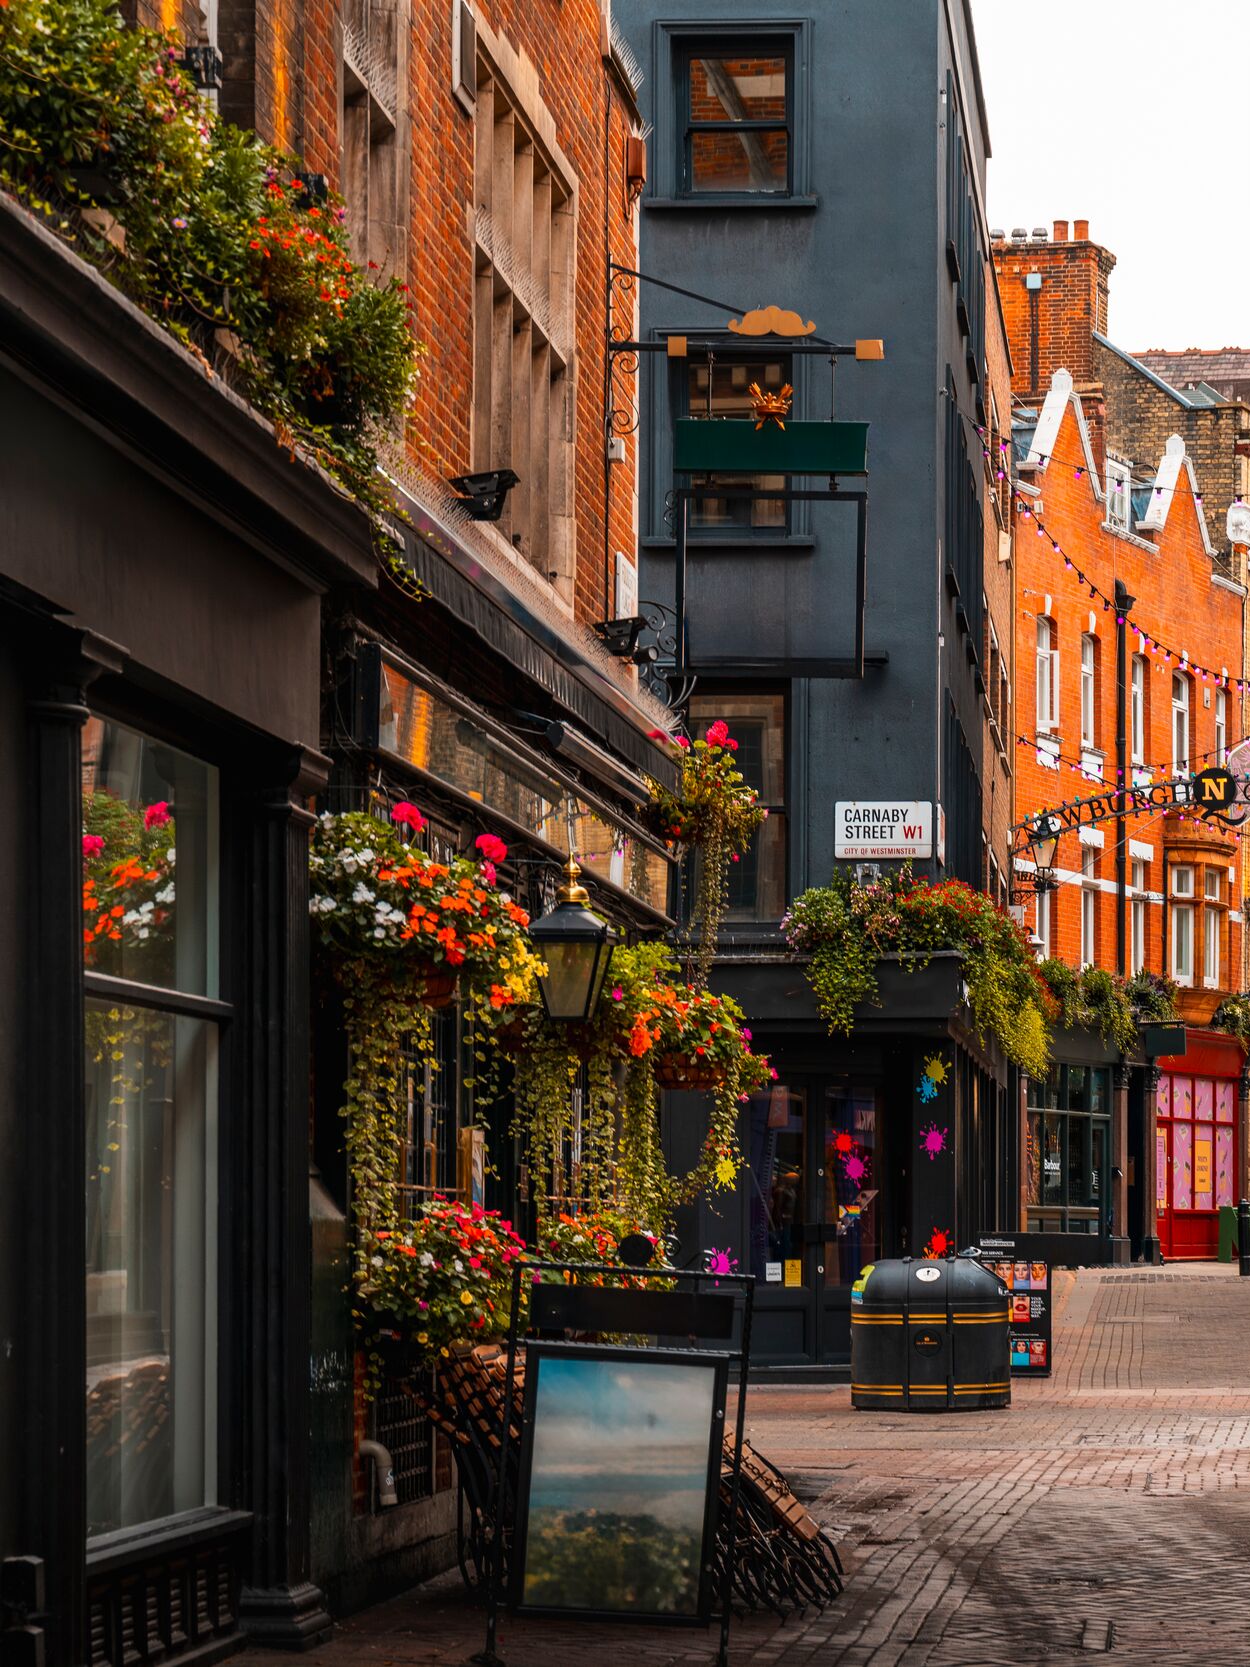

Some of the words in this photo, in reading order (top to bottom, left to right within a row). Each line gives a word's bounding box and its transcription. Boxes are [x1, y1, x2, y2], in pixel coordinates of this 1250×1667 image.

[1027, 782, 1192, 840] EWBURGH
[1202, 777, 1228, 802] N
[844, 809, 909, 823] CARNABY
[845, 825, 896, 839] STREET
[903, 825, 923, 840] W1
[844, 847, 859, 855] CITY
[860, 847, 868, 855] OF
[870, 847, 917, 855] WESTMINSTER
